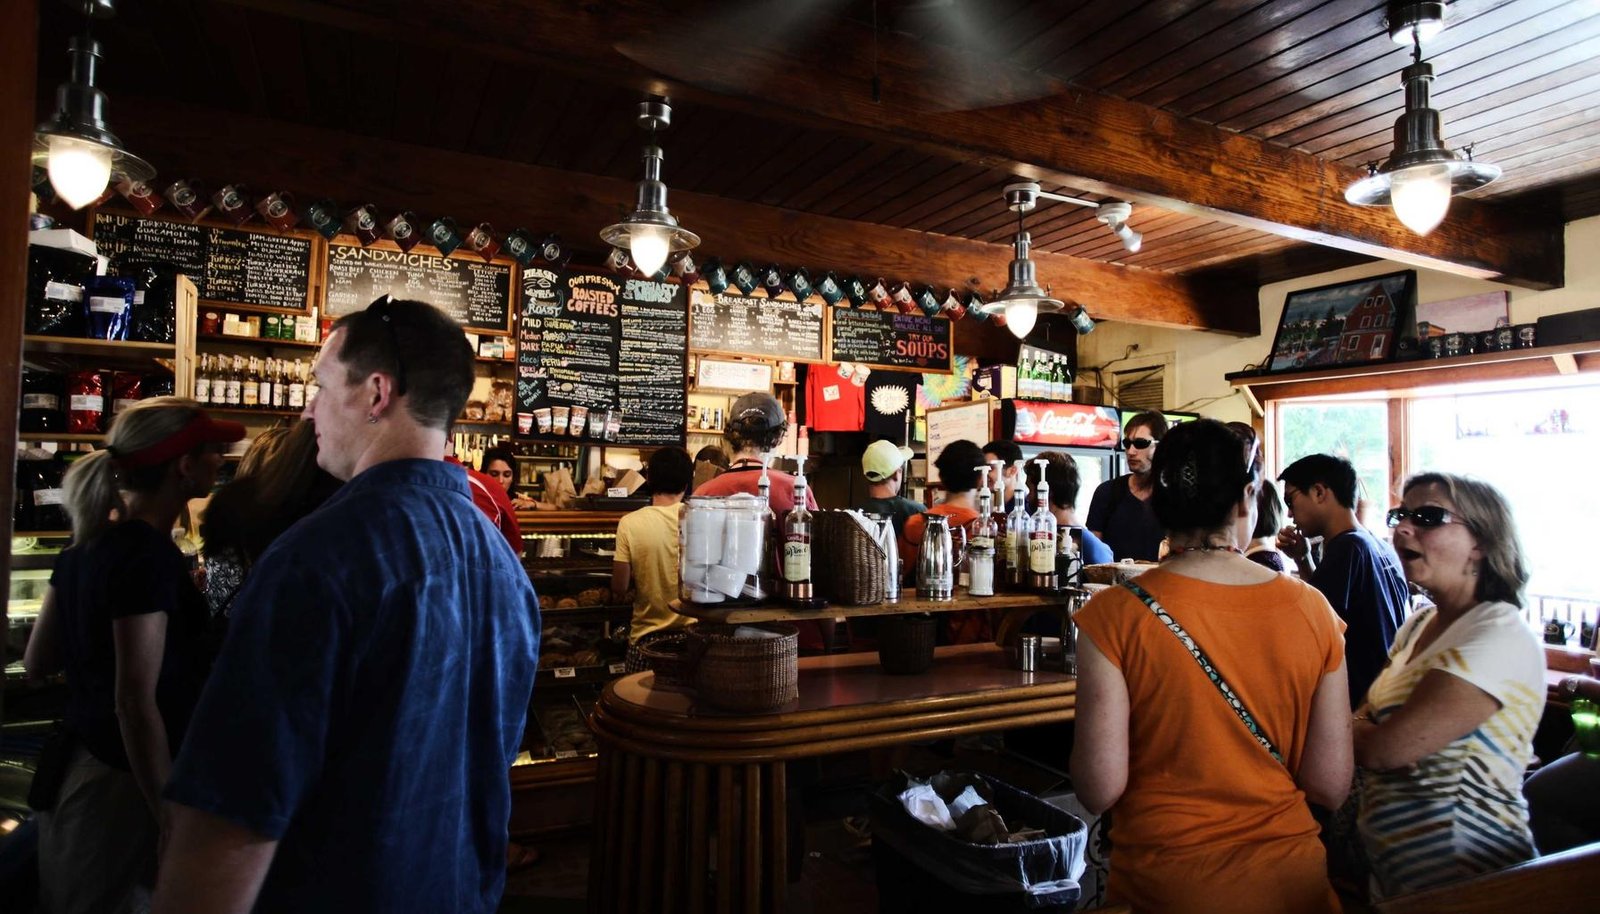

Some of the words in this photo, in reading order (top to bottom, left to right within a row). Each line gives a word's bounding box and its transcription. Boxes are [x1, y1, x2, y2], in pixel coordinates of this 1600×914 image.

[336, 246, 452, 270] SANDWICHES
[369, 268, 399, 276] CHICKEN
[568, 275, 584, 288] OUR
[585, 275, 620, 296] FRESHLY
[572, 287, 614, 304] ROASTED
[567, 299, 618, 317] COFFEES
[522, 317, 542, 328] MILD
[520, 342, 541, 352] DARK
[542, 341, 564, 350] PAPUA
[896, 340, 948, 360] SOUPS
[541, 358, 561, 367] PERU
